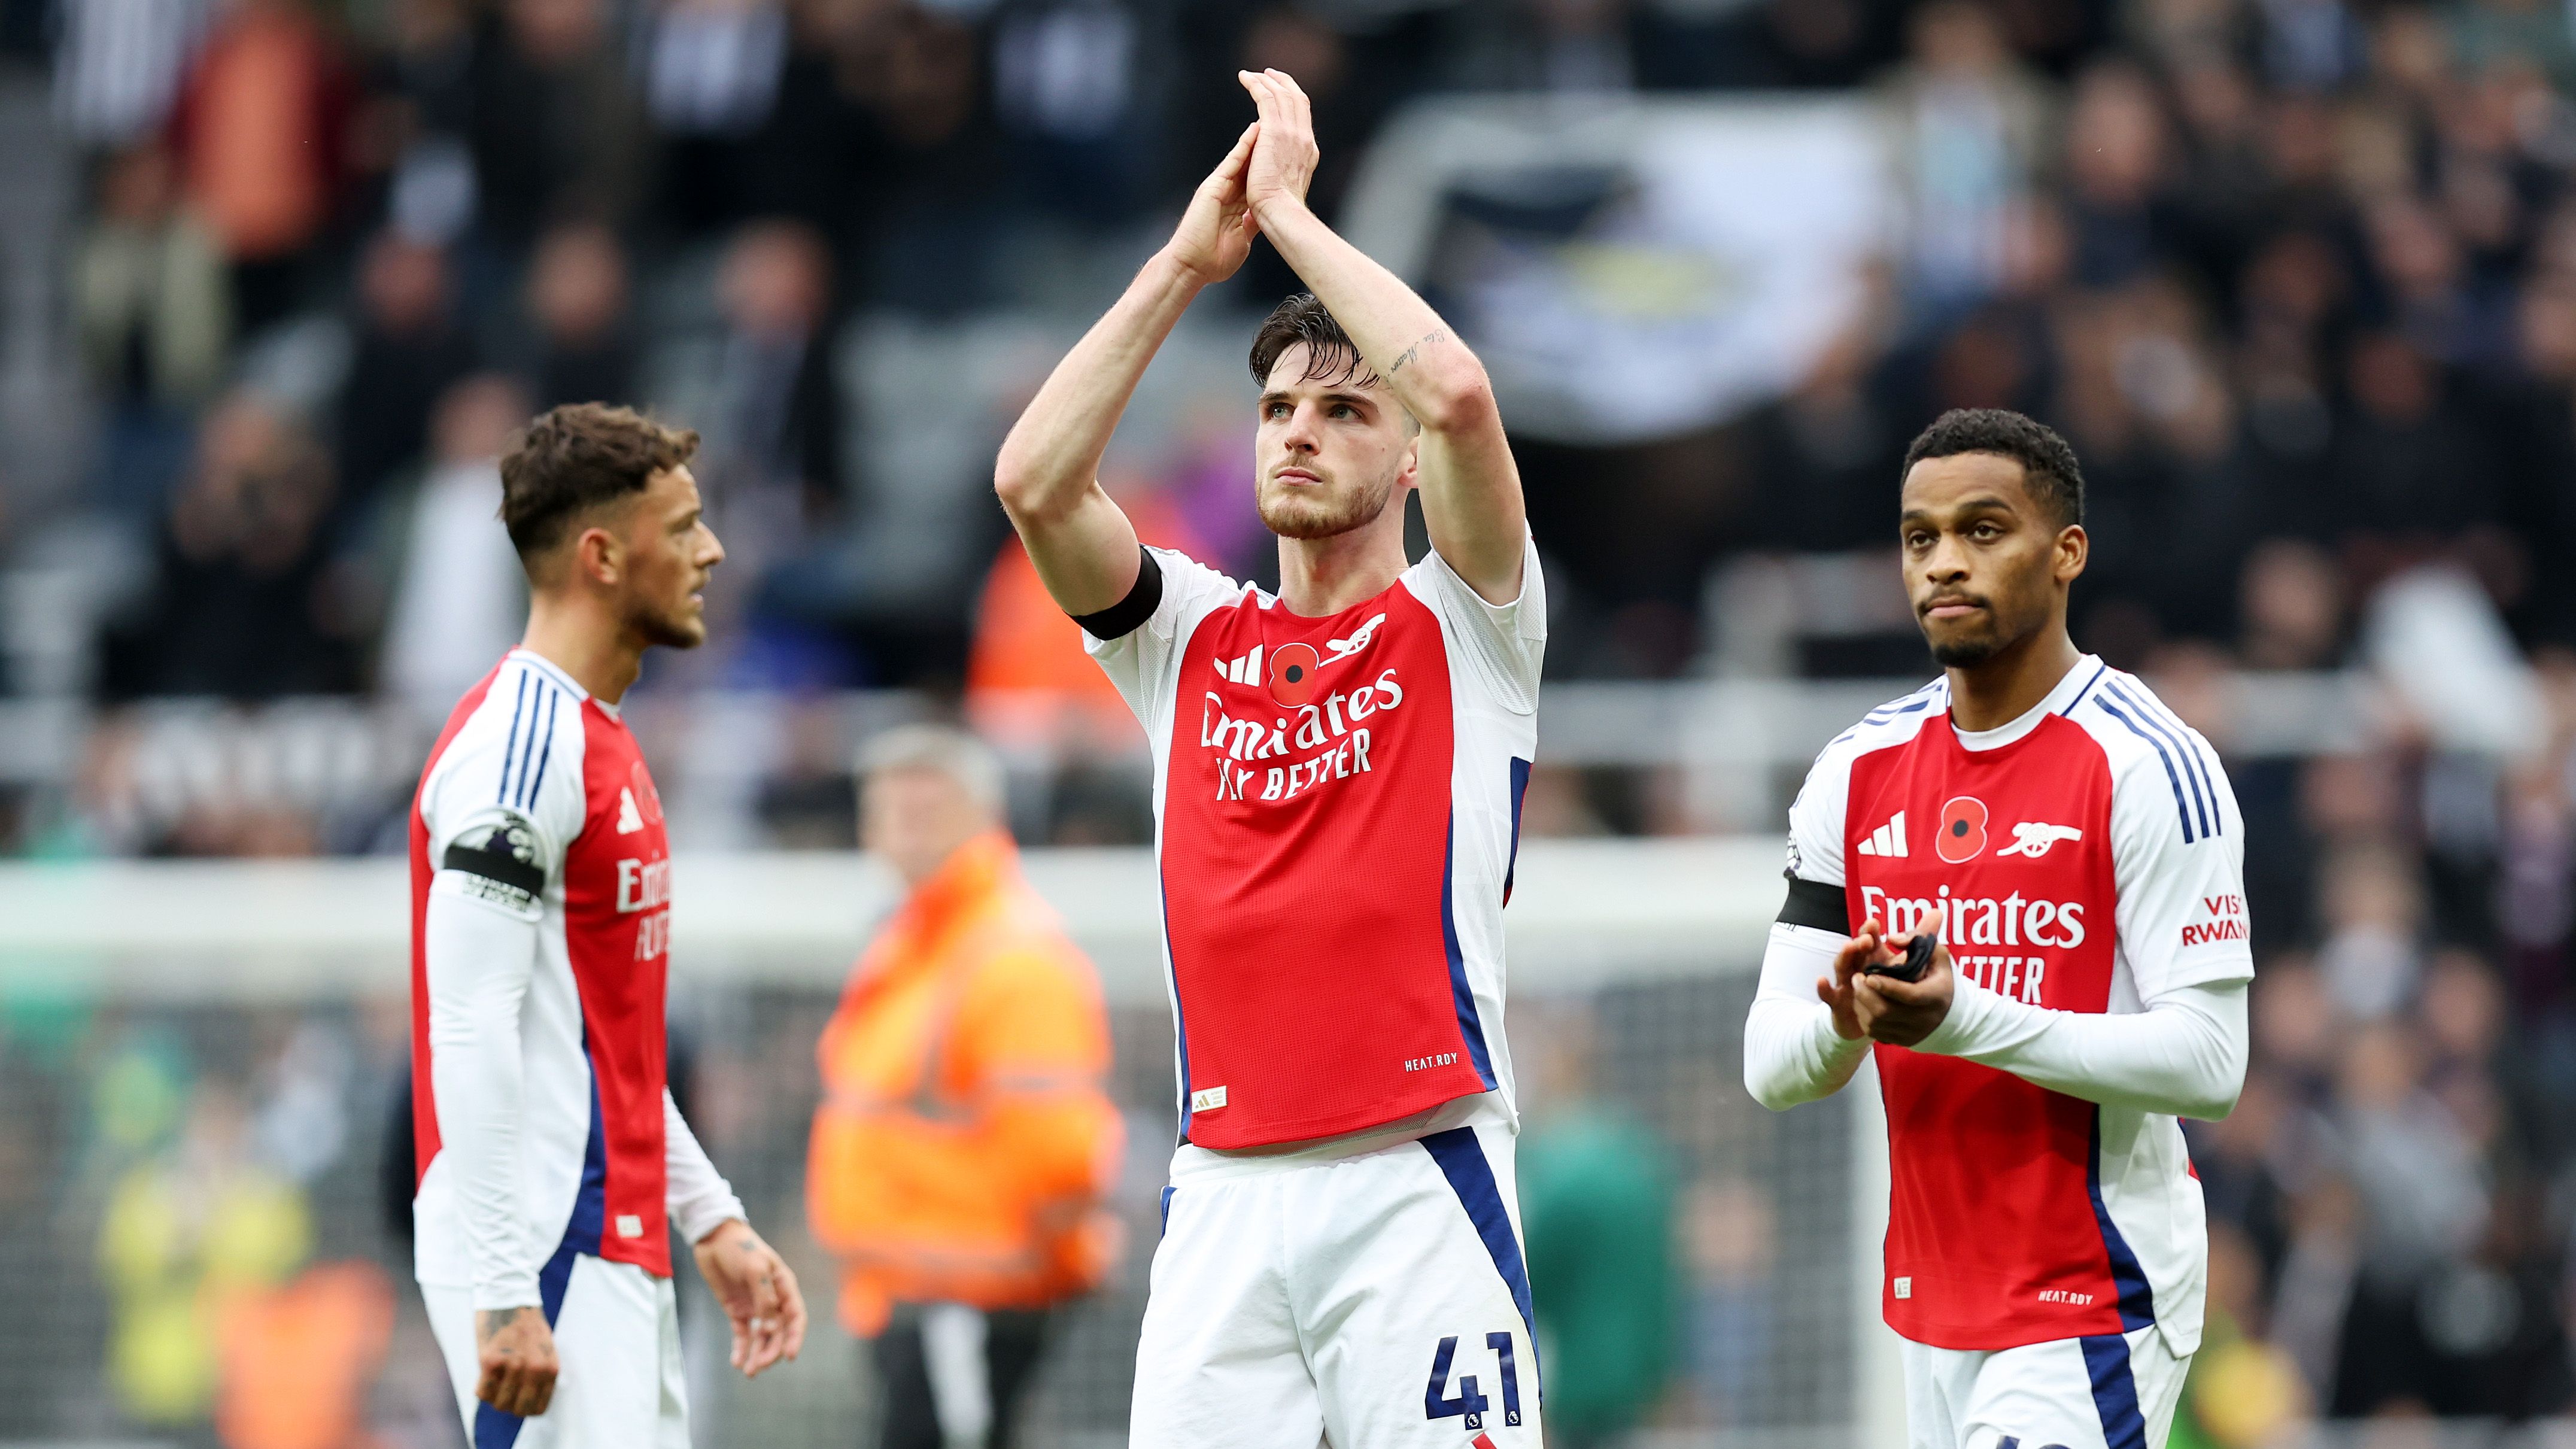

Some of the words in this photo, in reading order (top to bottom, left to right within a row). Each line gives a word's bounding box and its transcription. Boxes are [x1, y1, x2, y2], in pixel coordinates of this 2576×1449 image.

[1259, 728, 1372, 801] BETTER
[1860, 884, 2086, 949] Emirates
[1405, 1052, 1457, 1073] HEAT.RDY
[2037, 1290, 2094, 1306] HEAT.RDY
[1424, 1331, 1522, 1431] 41
